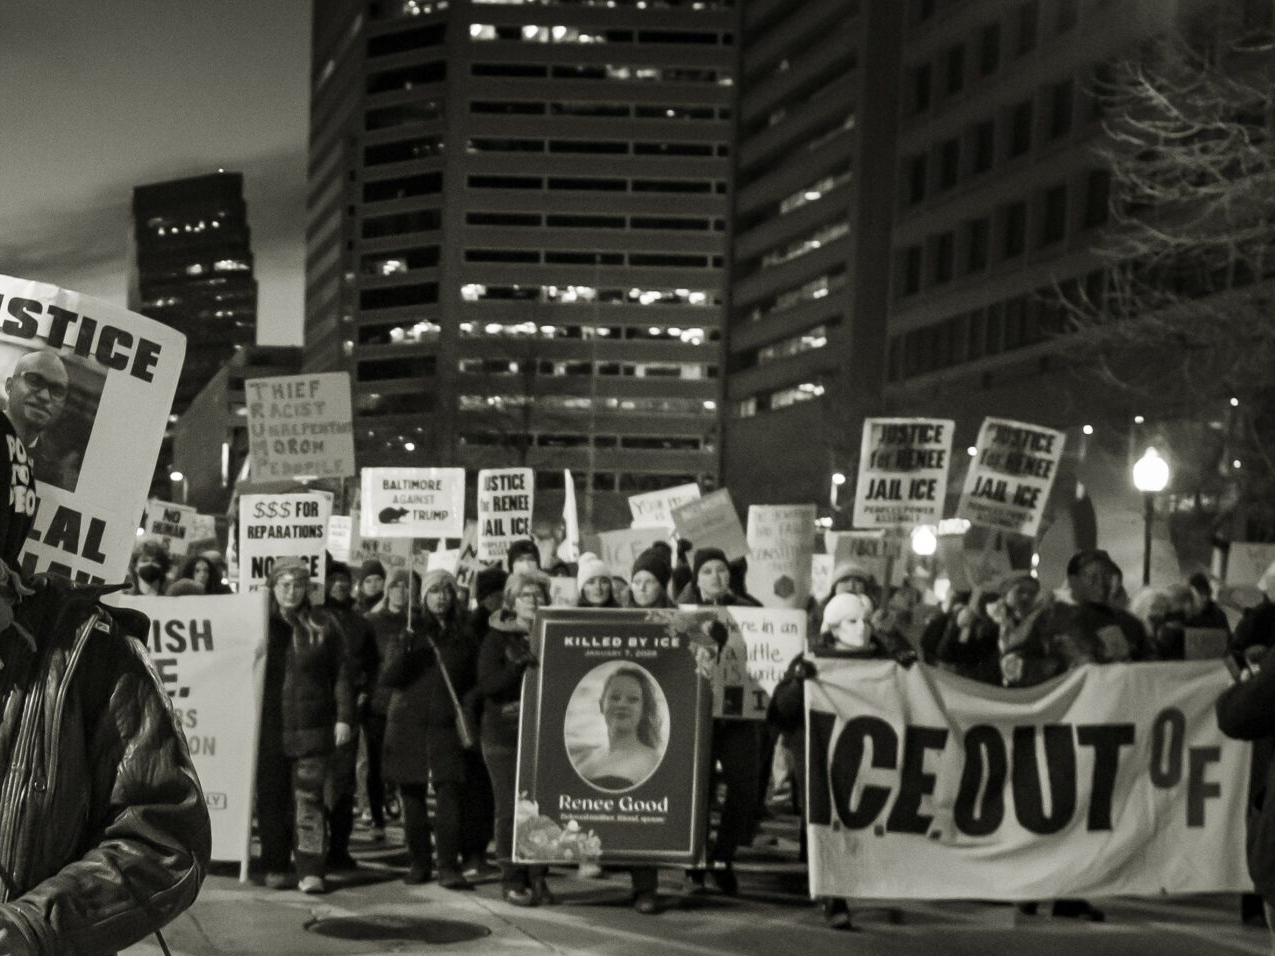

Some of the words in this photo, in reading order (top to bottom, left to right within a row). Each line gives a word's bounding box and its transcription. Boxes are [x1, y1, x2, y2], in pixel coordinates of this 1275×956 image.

[249, 380, 319, 400] THIEF
[250, 401, 325, 418] RACIST
[878, 424, 944, 444] JUSTICE
[992, 425, 1056, 454] JUSTICE
[895, 449, 945, 471] RENEE
[383, 480, 442, 490] BALTIMORE
[485, 474, 524, 491] USTICE
[866, 479, 902, 500] JAIL
[909, 479, 937, 500] ICE
[393, 493, 434, 504] AGAINST
[971, 476, 1007, 503] JAIL
[1013, 483, 1041, 509] ICE
[253, 501, 292, 518] $$$
[295, 501, 319, 518] FOR
[493, 495, 529, 512] RENEE
[164, 508, 180, 523] NO
[413, 509, 449, 520] TRUMP
[247, 525, 324, 539] REPARATIONS
[149, 619, 214, 653] ISH
[781, 622, 799, 635] an
[564, 636, 622, 648] KILLED
[628, 636, 648, 648] BY
[654, 636, 680, 648] ICE
[954, 723, 1135, 837] OUT
[1149, 706, 1221, 828] OF
[559, 794, 614, 811] Renee
[619, 795, 669, 813] Good
